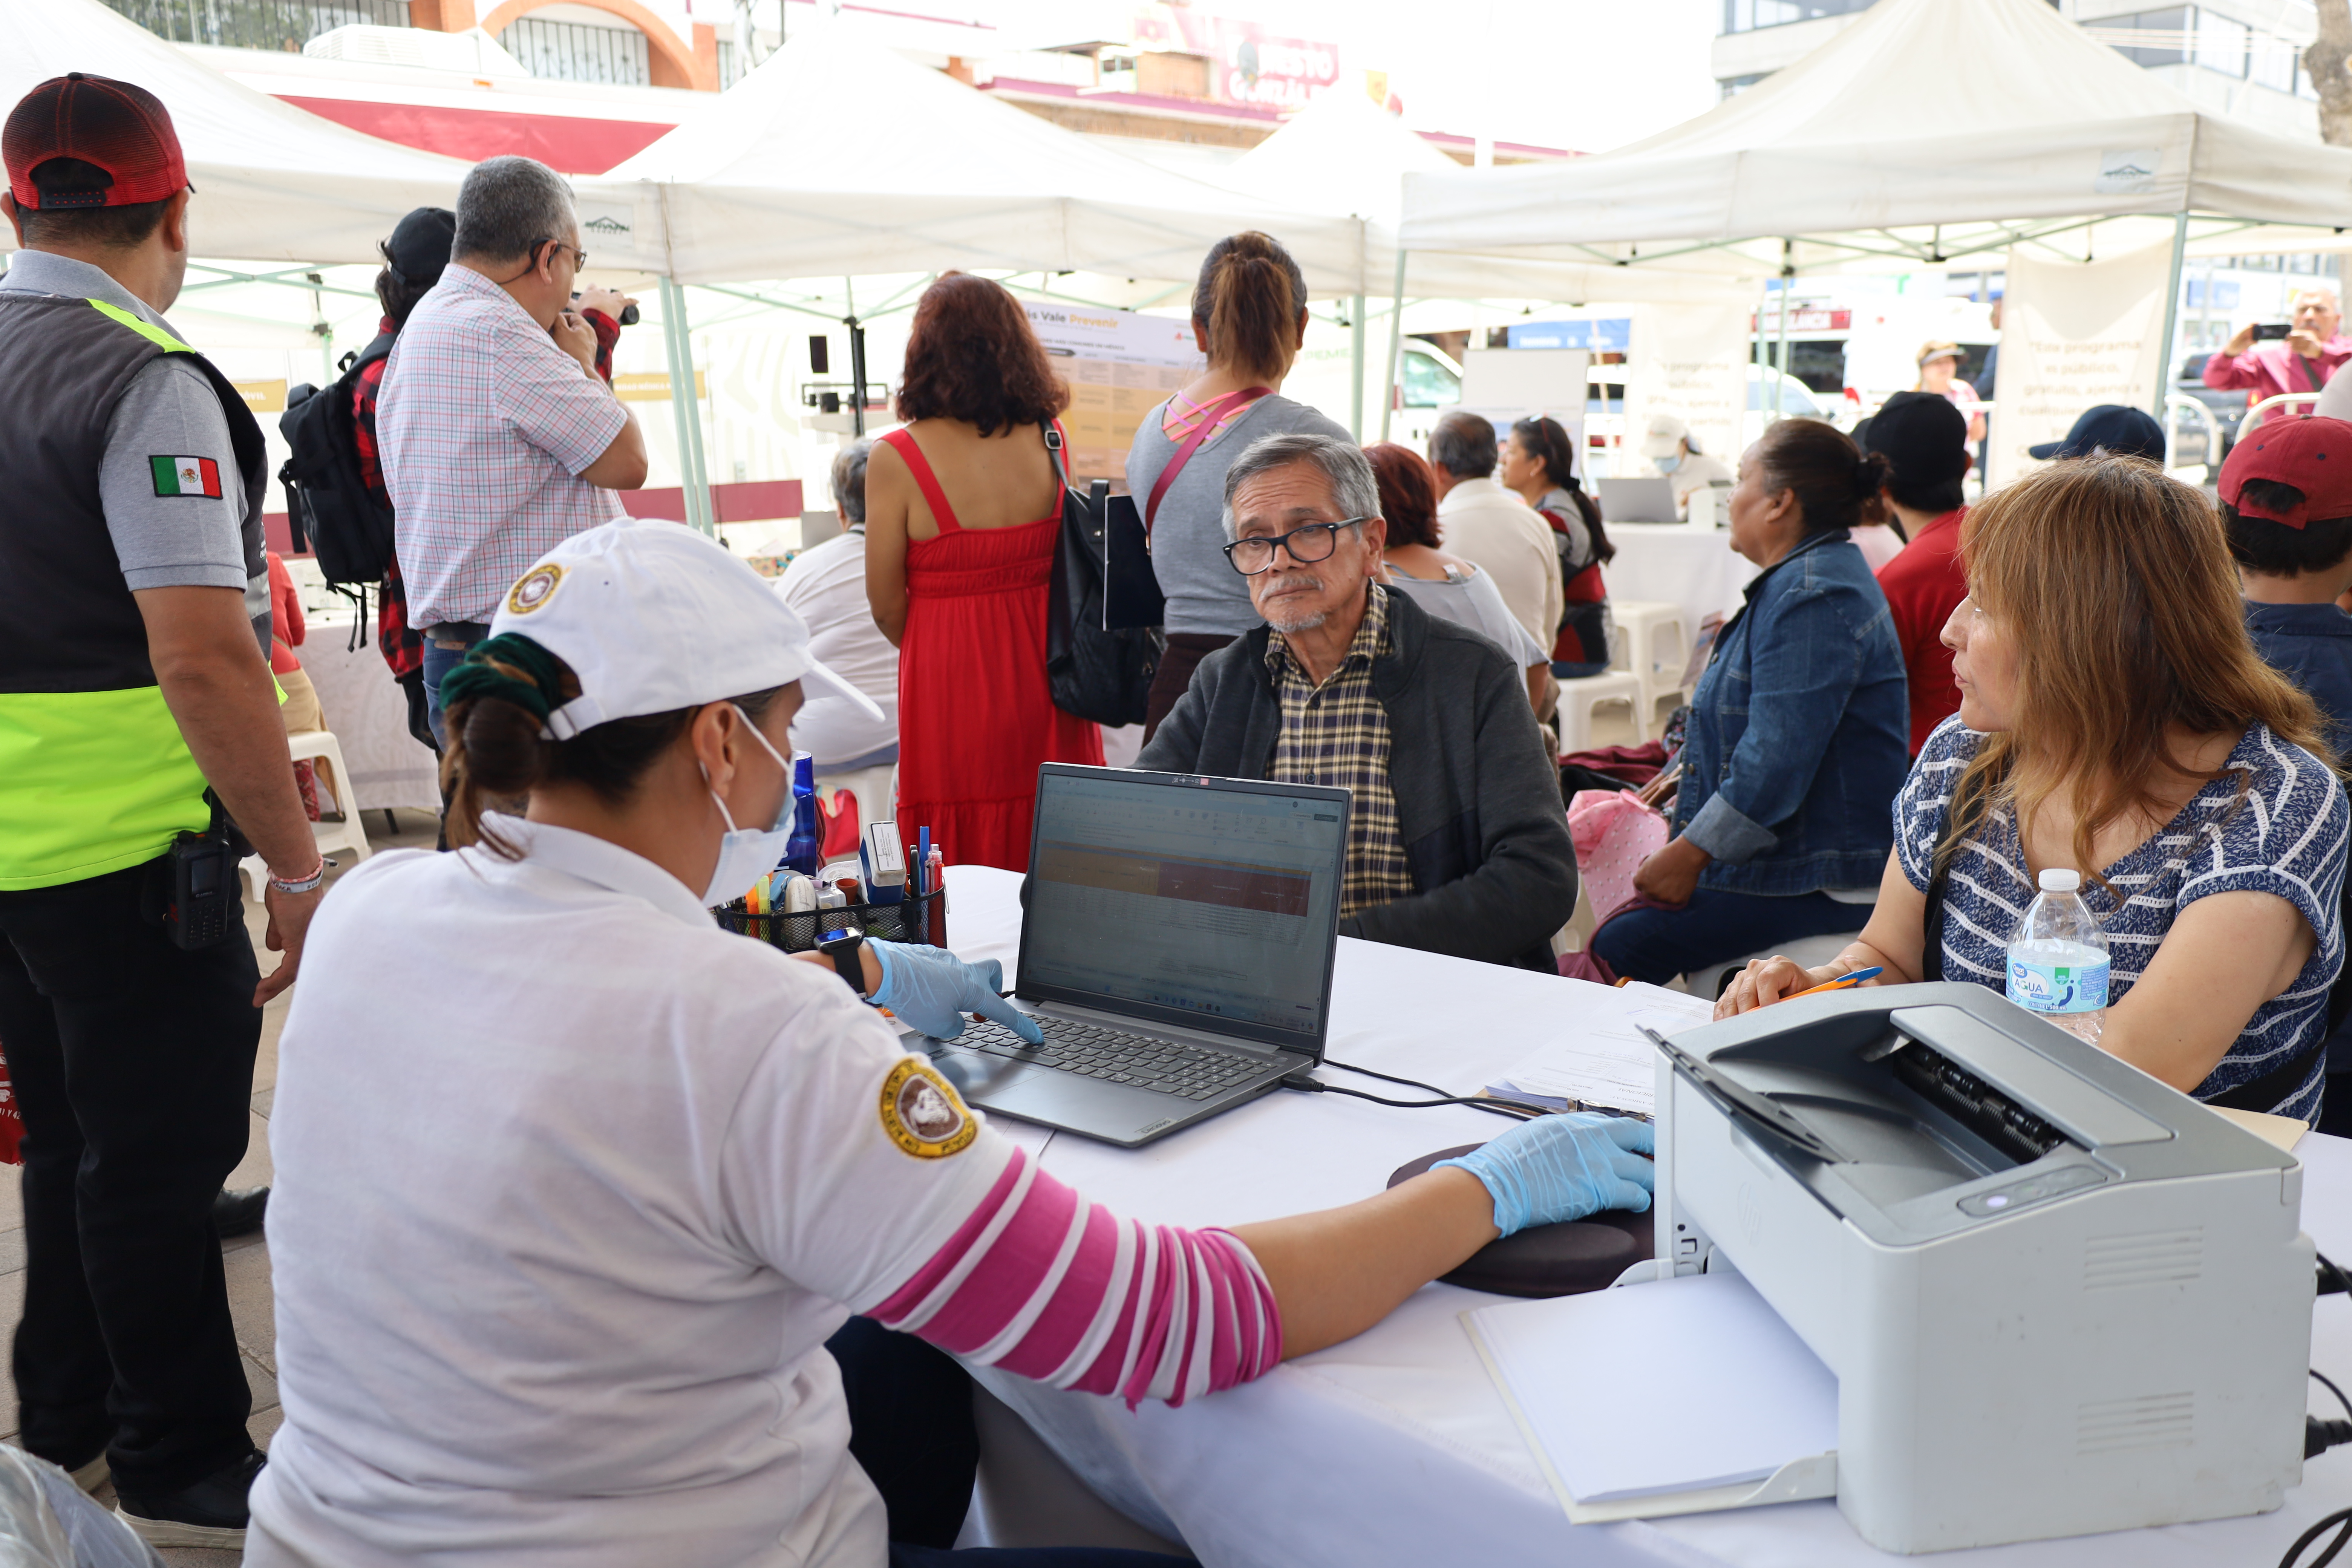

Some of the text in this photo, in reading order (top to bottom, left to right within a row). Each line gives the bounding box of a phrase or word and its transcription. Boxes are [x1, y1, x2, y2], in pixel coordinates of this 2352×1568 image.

[1041, 311, 1066, 322] Vale
[1070, 314, 1118, 328] Prevenir
[2064, 341, 2141, 354] programa
[1670, 361, 1729, 374] programa
[639, 380, 665, 390] MÉDICA
[2013, 965, 2025, 973] Great
[2015, 978, 2043, 994] AGUA
[1618, 1088, 1655, 1098] TRICIONAL
[1141, 1120, 1171, 1134] Lenovo
